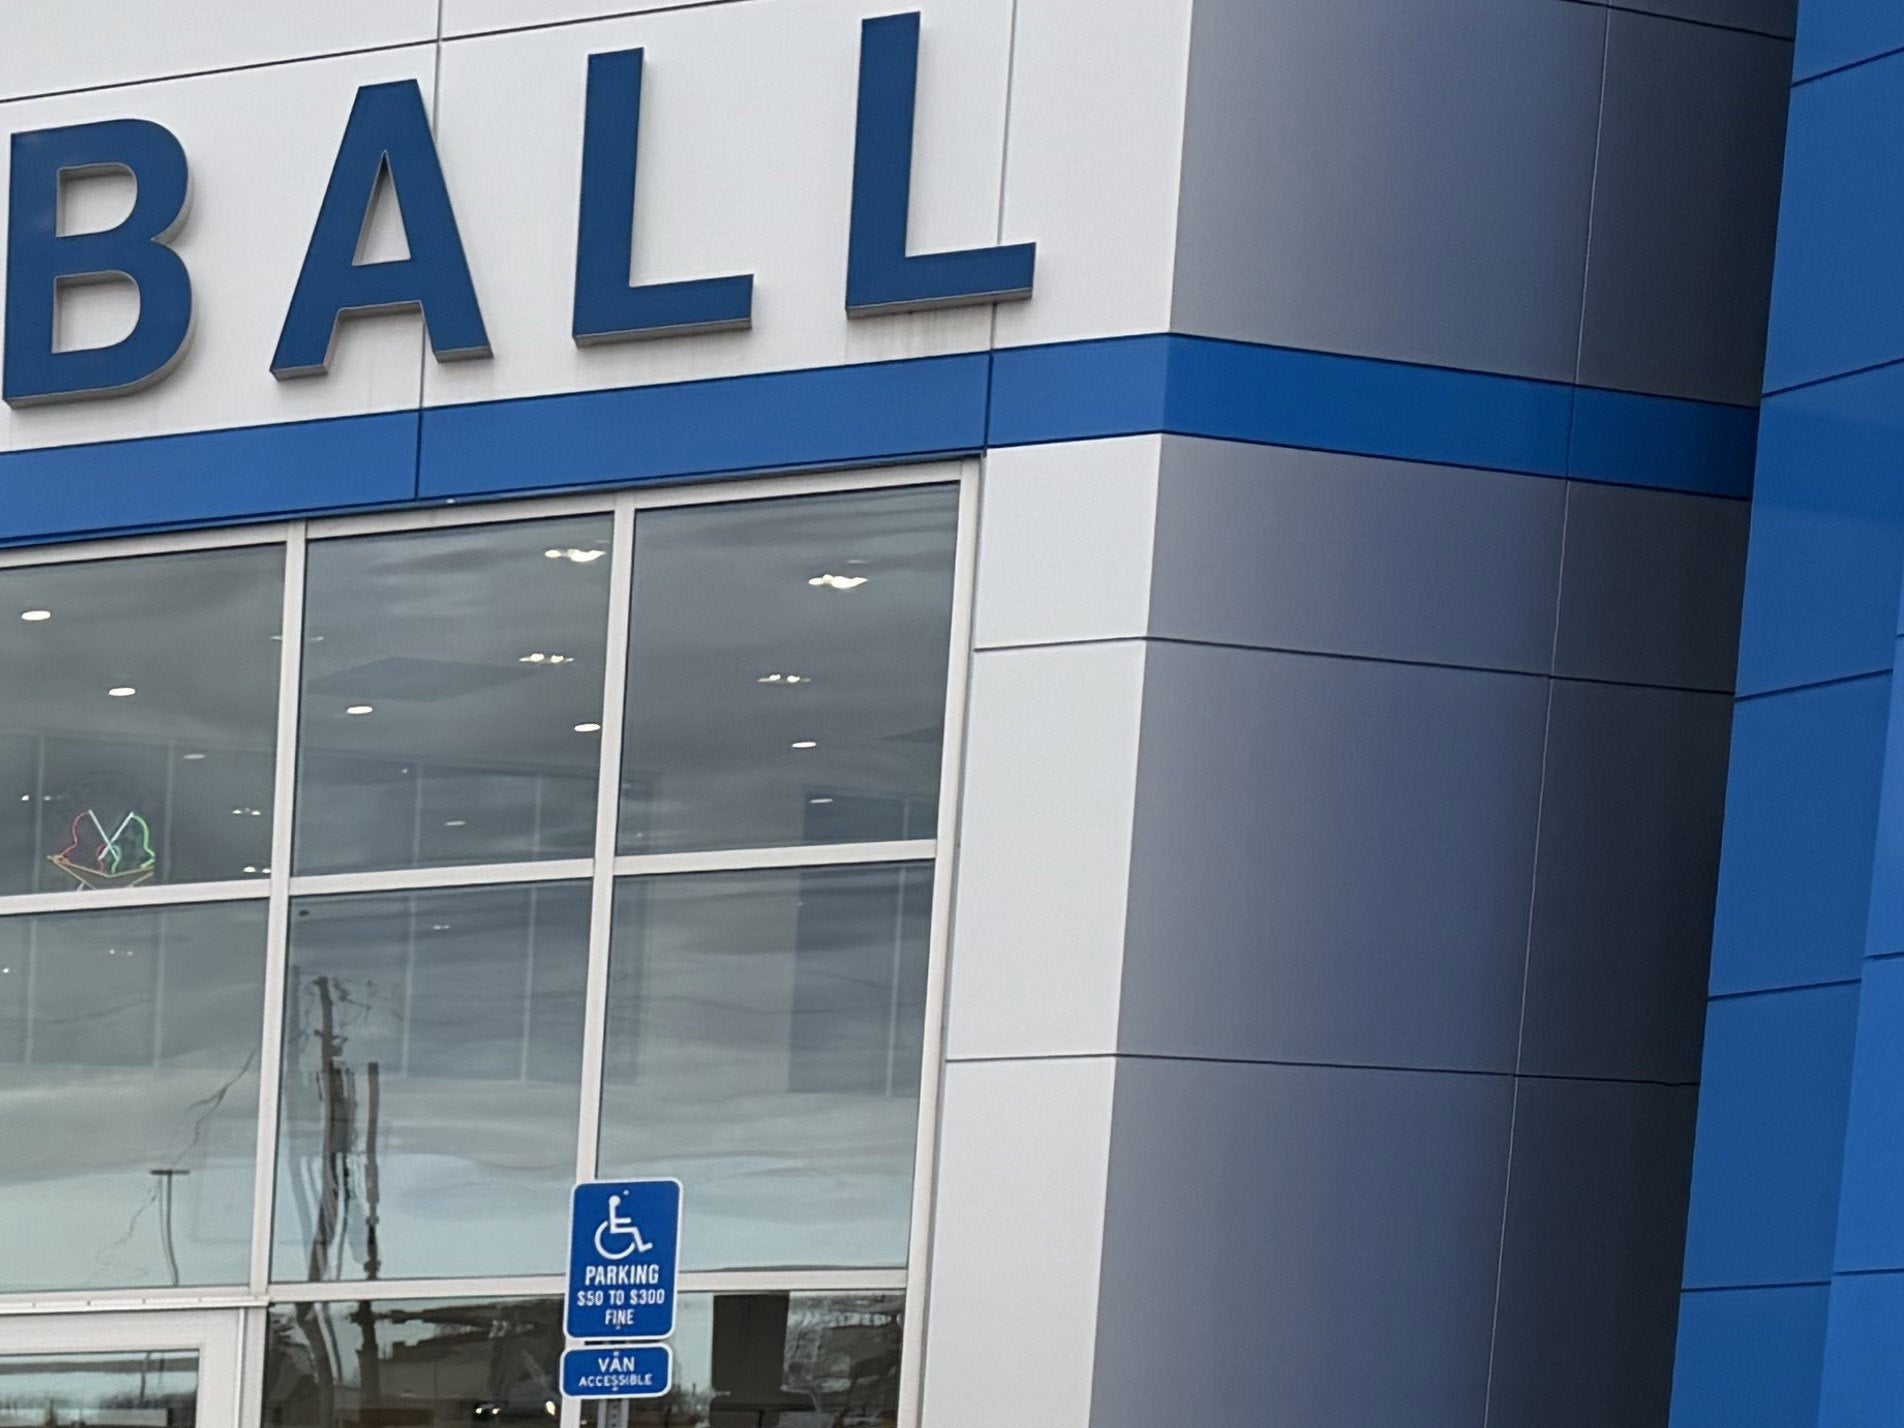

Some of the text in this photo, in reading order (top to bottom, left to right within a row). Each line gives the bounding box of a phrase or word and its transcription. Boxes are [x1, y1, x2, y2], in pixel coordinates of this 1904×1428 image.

[1, 11, 1036, 408] BALL
[584, 1264, 659, 1285] PARKING
[576, 1289, 665, 1306] $50 TO $300
[604, 1309, 635, 1325] FINE
[598, 1356, 635, 1373] VAN
[579, 1373, 653, 1387] ACCESSIBLE
